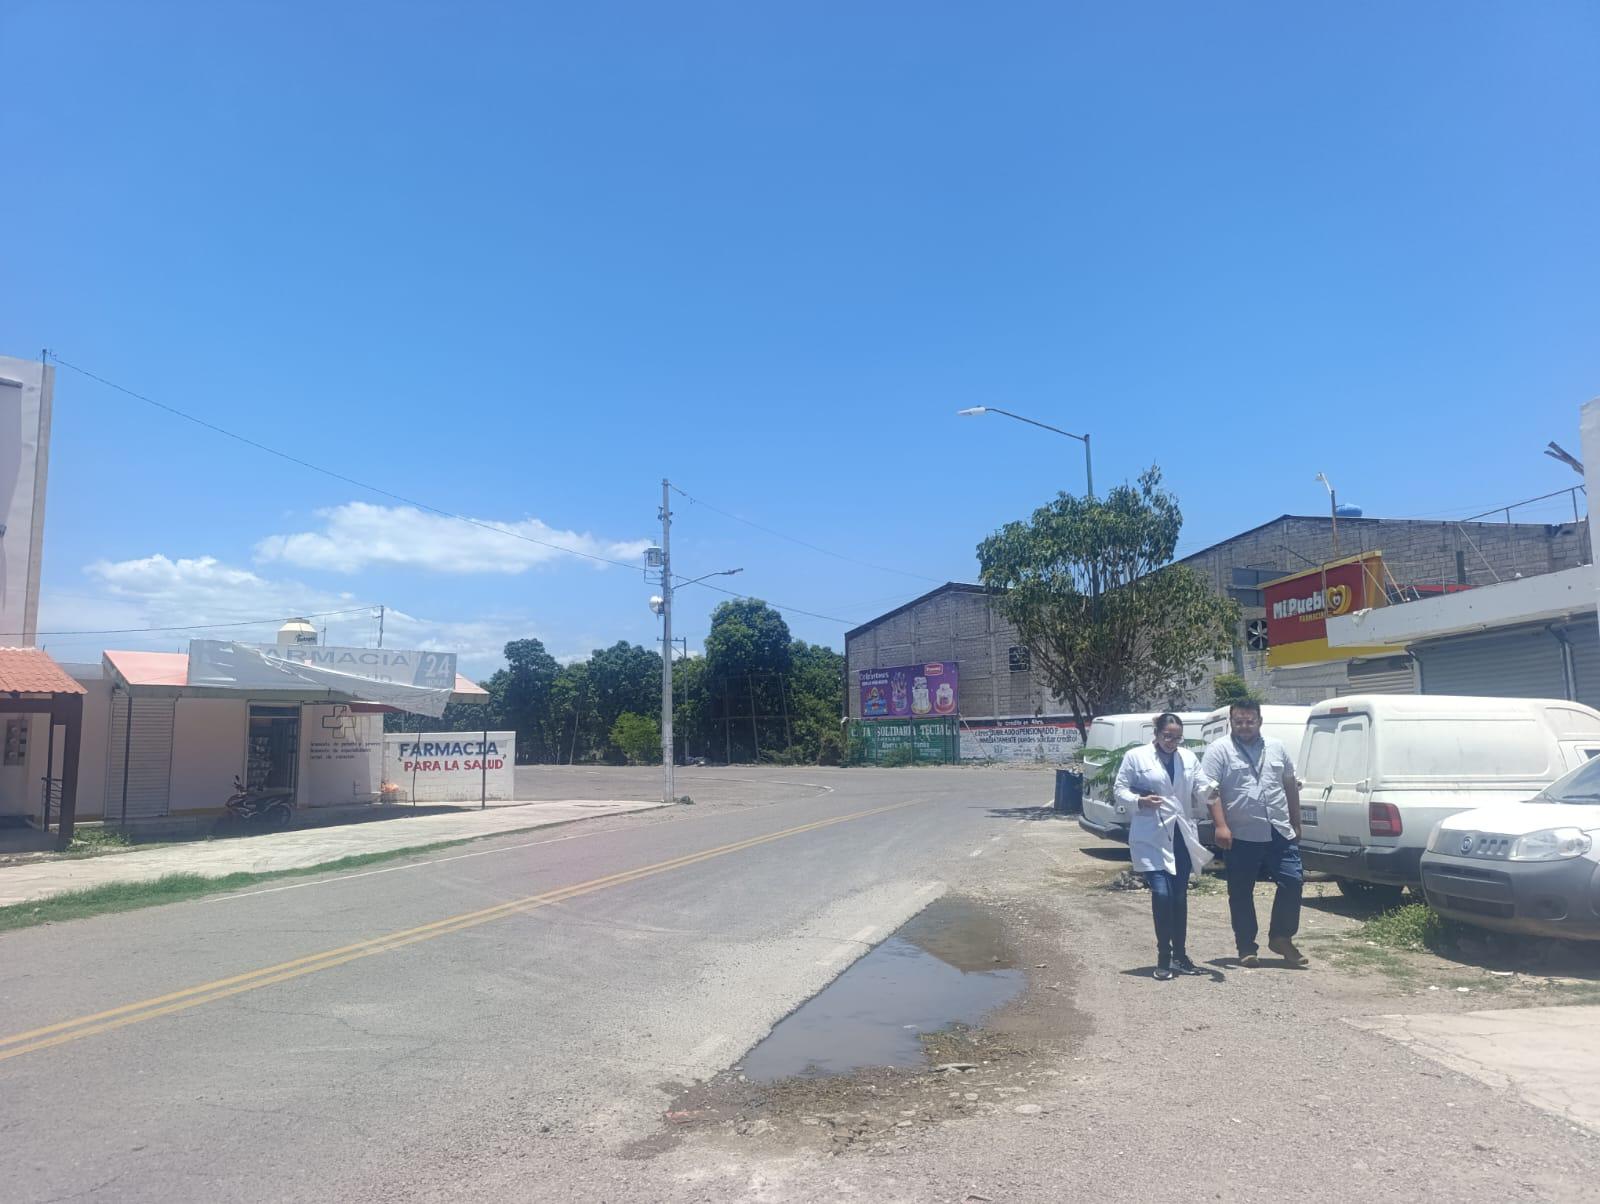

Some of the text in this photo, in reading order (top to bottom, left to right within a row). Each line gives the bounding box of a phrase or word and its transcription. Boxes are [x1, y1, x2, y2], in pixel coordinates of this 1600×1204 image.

[265, 647, 410, 666] ARMACIA
[425, 653, 450, 677] 24
[399, 741, 498, 757] FARMACIA
[444, 760, 460, 770] LA
